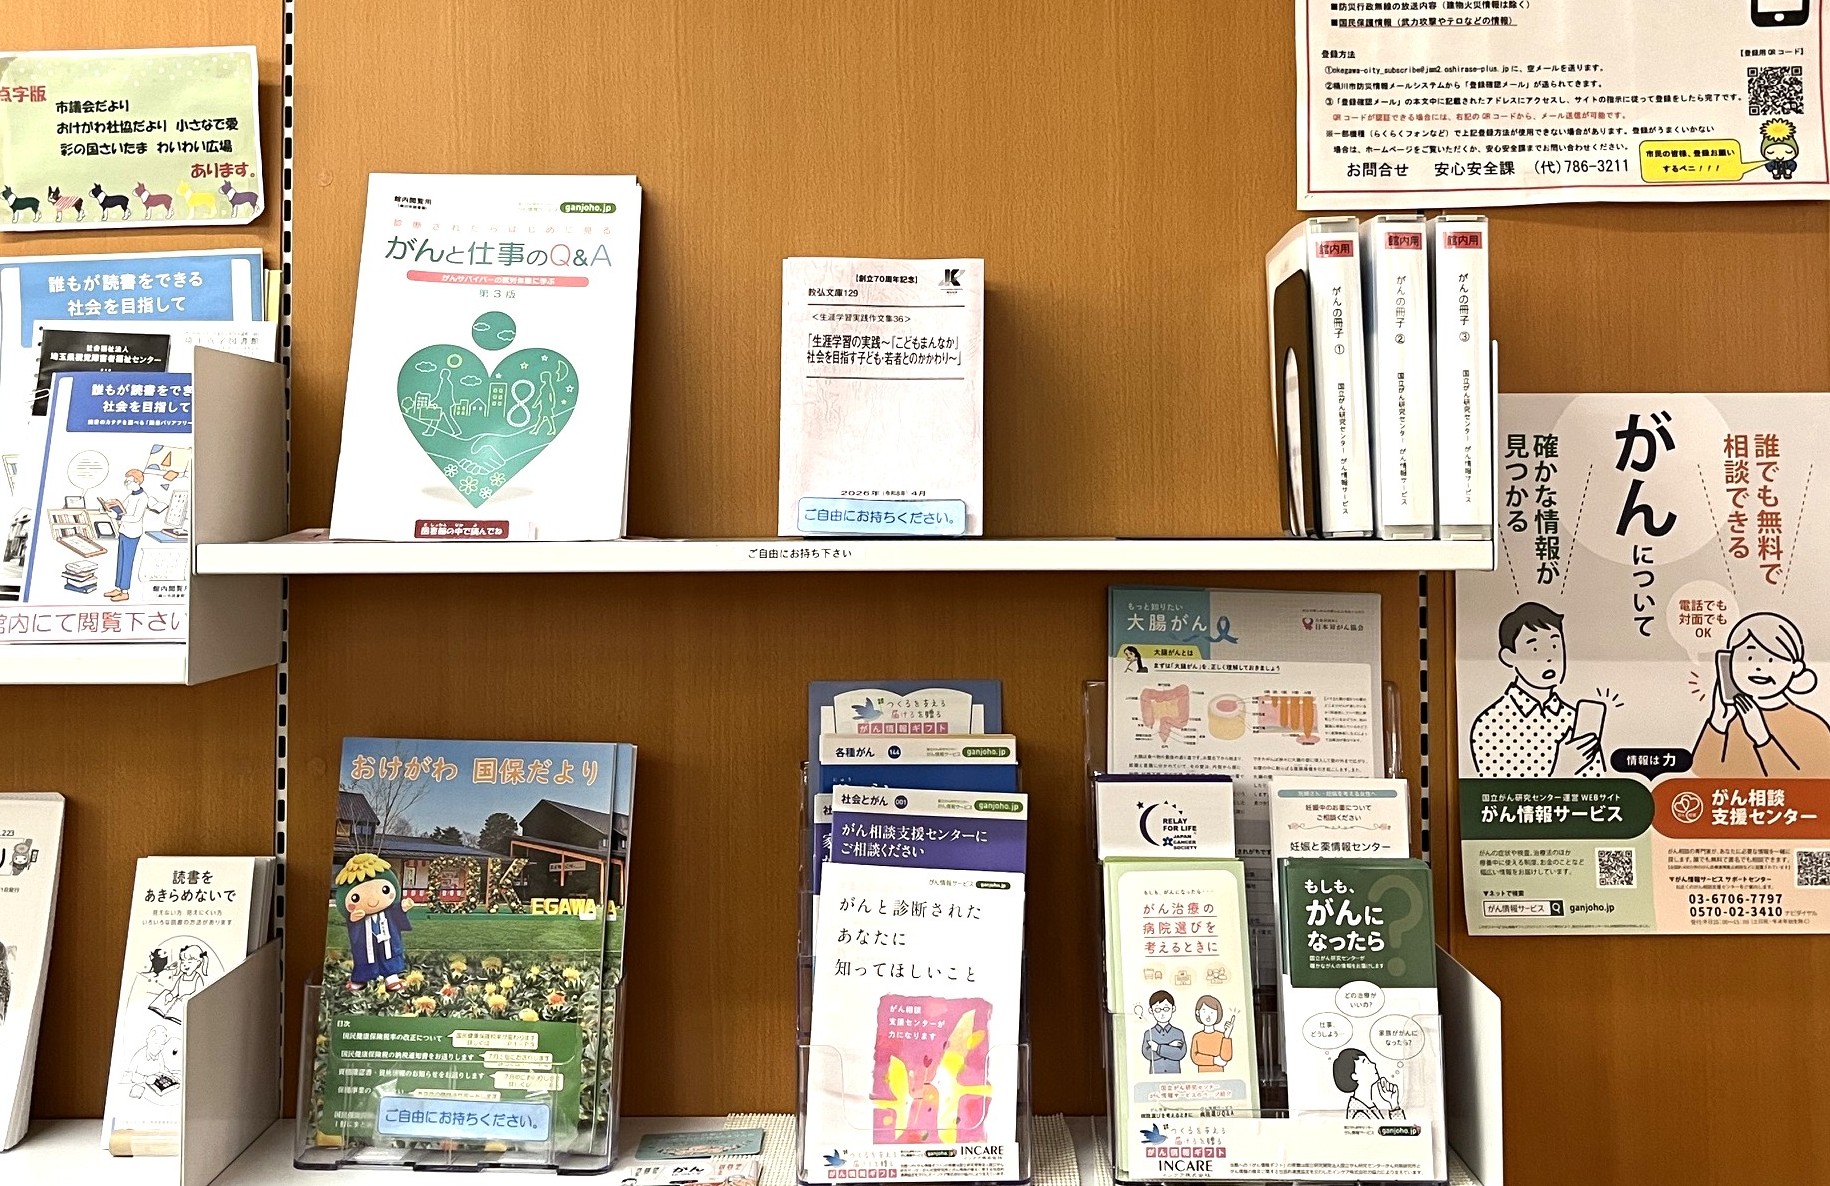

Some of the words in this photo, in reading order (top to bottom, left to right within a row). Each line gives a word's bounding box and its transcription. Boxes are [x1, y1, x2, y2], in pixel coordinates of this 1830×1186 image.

[1321, 50, 1356, 59] 登録方法
[0, 86, 47, 102] 点字版
[55, 100, 130, 114] 市議会だより
[56, 119, 167, 134] おけがわ社協だより
[176, 117, 239, 132] 小さなで愛
[60, 142, 148, 156] 彩の国さいたま
[157, 139, 233, 154] わいわい広場
[191, 162, 256, 178] あります。
[1346, 162, 1409, 177] お問合せ
[1434, 161, 1516, 176] 安心安全課
[564, 203, 612, 214] ganjoho.jp
[1388, 233, 1420, 247] 館内用
[1448, 234, 1479, 246] 館内用
[385, 235, 612, 267] がんと仕事のQ&A
[1319, 242, 1350, 255] 館内用
[48, 271, 203, 293] 誰もが読書をできる
[808, 288, 859, 297] 教弘文庫129
[1458, 273, 1470, 326] がんの冊子
[67, 296, 186, 317] 社会を目指して
[1395, 275, 1407, 329] がんの冊子
[1332, 286, 1345, 339] がんの冊子
[102, 401, 190, 413] 社会を目指して
[1615, 410, 1678, 537] がん
[1504, 434, 1530, 533] 見つかる
[1723, 434, 1749, 559] 相談できる
[804, 508, 954, 525] ご自由にお持ちください。
[1533, 434, 1560, 585] 確かな情報が
[1753, 434, 1784, 585] 誰でも無料で
[748, 548, 852, 559] ご自由にお持ち下さい
[1632, 544, 1656, 637] について
[1128, 603, 1183, 611] もっと知りたい
[1678, 599, 1727, 611] 電話でも
[1127, 613, 1208, 632] 大腸がん
[1678, 613, 1727, 626] 対面でも
[1695, 628, 1712, 639] OK
[1153, 649, 1194, 657] 大腸がんとは
[858, 723, 948, 734] がん情報ギフト
[835, 747, 875, 758] 各種がん
[966, 748, 1006, 757] ganjoho.jp
[1626, 753, 1676, 767] 情報は力
[351, 755, 459, 782] おけがわ
[472, 757, 598, 786] 国保だより
[841, 793, 889, 807] 社会とがん
[1711, 789, 1785, 807] がん相談
[978, 802, 1019, 811] ganjoho.jp
[1481, 805, 1623, 823] がん情報サービス
[1711, 808, 1818, 826] 支援センター
[841, 823, 988, 842] がん相談支援センターに
[841, 842, 925, 858] ご相談ください
[1290, 841, 1391, 852] 妊娠と薬情報センター
[172, 870, 214, 885] 読書を
[1304, 879, 1355, 894] もしも、
[144, 888, 237, 903] あきらめないで
[1688, 893, 1783, 904] 03-6706-7797
[840, 897, 981, 919] がんと診断された
[1143, 902, 1214, 915] がん治療の
[1305, 897, 1384, 927] がんに
[1487, 904, 1545, 913] がん情報サービス
[1569, 903, 1615, 912] ganjoho.jp
[1689, 906, 1783, 917] 0570-02-3410
[1143, 921, 1216, 935] 病院選びを
[837, 928, 906, 946] あなたに
[1307, 930, 1385, 952] なったら
[1144, 941, 1218, 954] 考えるときに
[834, 958, 976, 982] 知ってほしいこと
[889, 1005, 922, 1014] がん相談
[888, 1018, 946, 1028] 支援センターが
[888, 1031, 936, 1041] 力になります
[1378, 1029, 1418, 1037] 家族ががんに
[385, 1108, 538, 1129] ご自由にお持ちください。
[1381, 1126, 1417, 1135] ganjoho.jp
[960, 1145, 1004, 1155] INCARE
[1146, 1147, 1226, 1158] がん情報ギフト
[1158, 1160, 1213, 1172] INCARE
